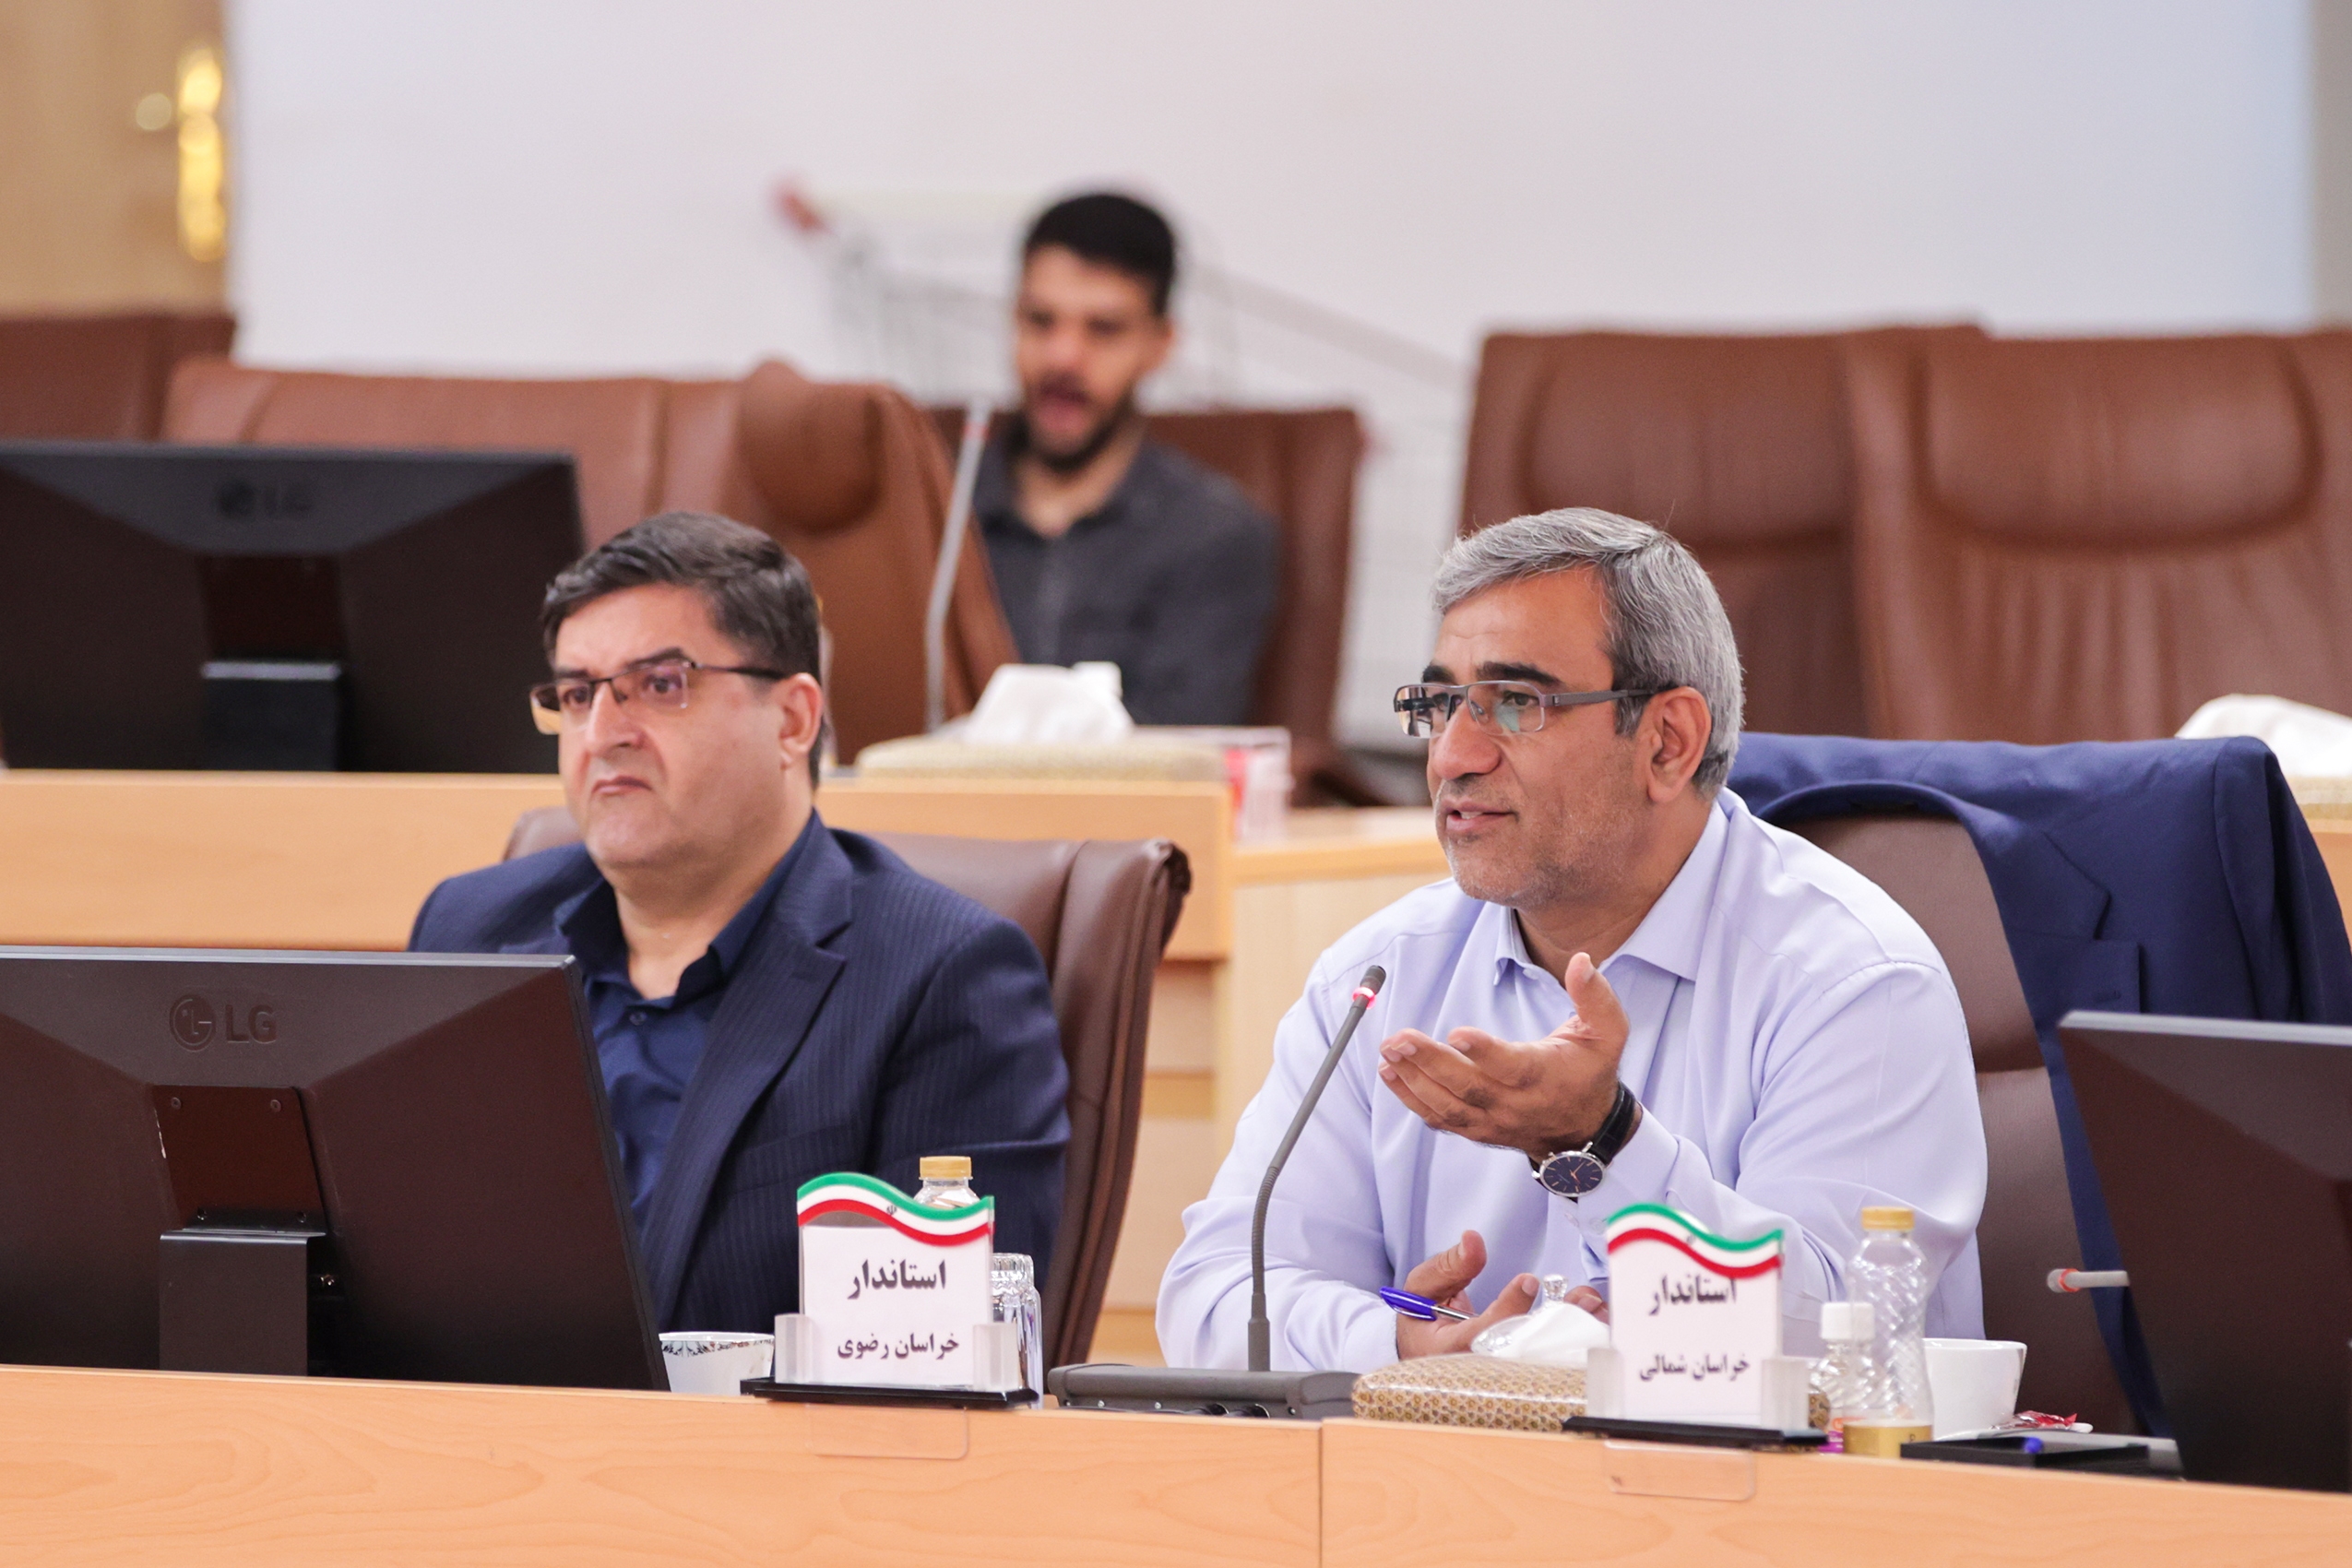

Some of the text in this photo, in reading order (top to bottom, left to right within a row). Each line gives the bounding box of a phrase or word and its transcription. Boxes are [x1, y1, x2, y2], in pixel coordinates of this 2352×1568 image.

[225, 1004, 277, 1044] LG
[846, 1258, 946, 1300] استاندار
[1648, 1274, 1737, 1316] استاندار
[837, 1332, 959, 1360] خراسان رضوی
[1639, 1352, 1750, 1382] خراسان شمالی
